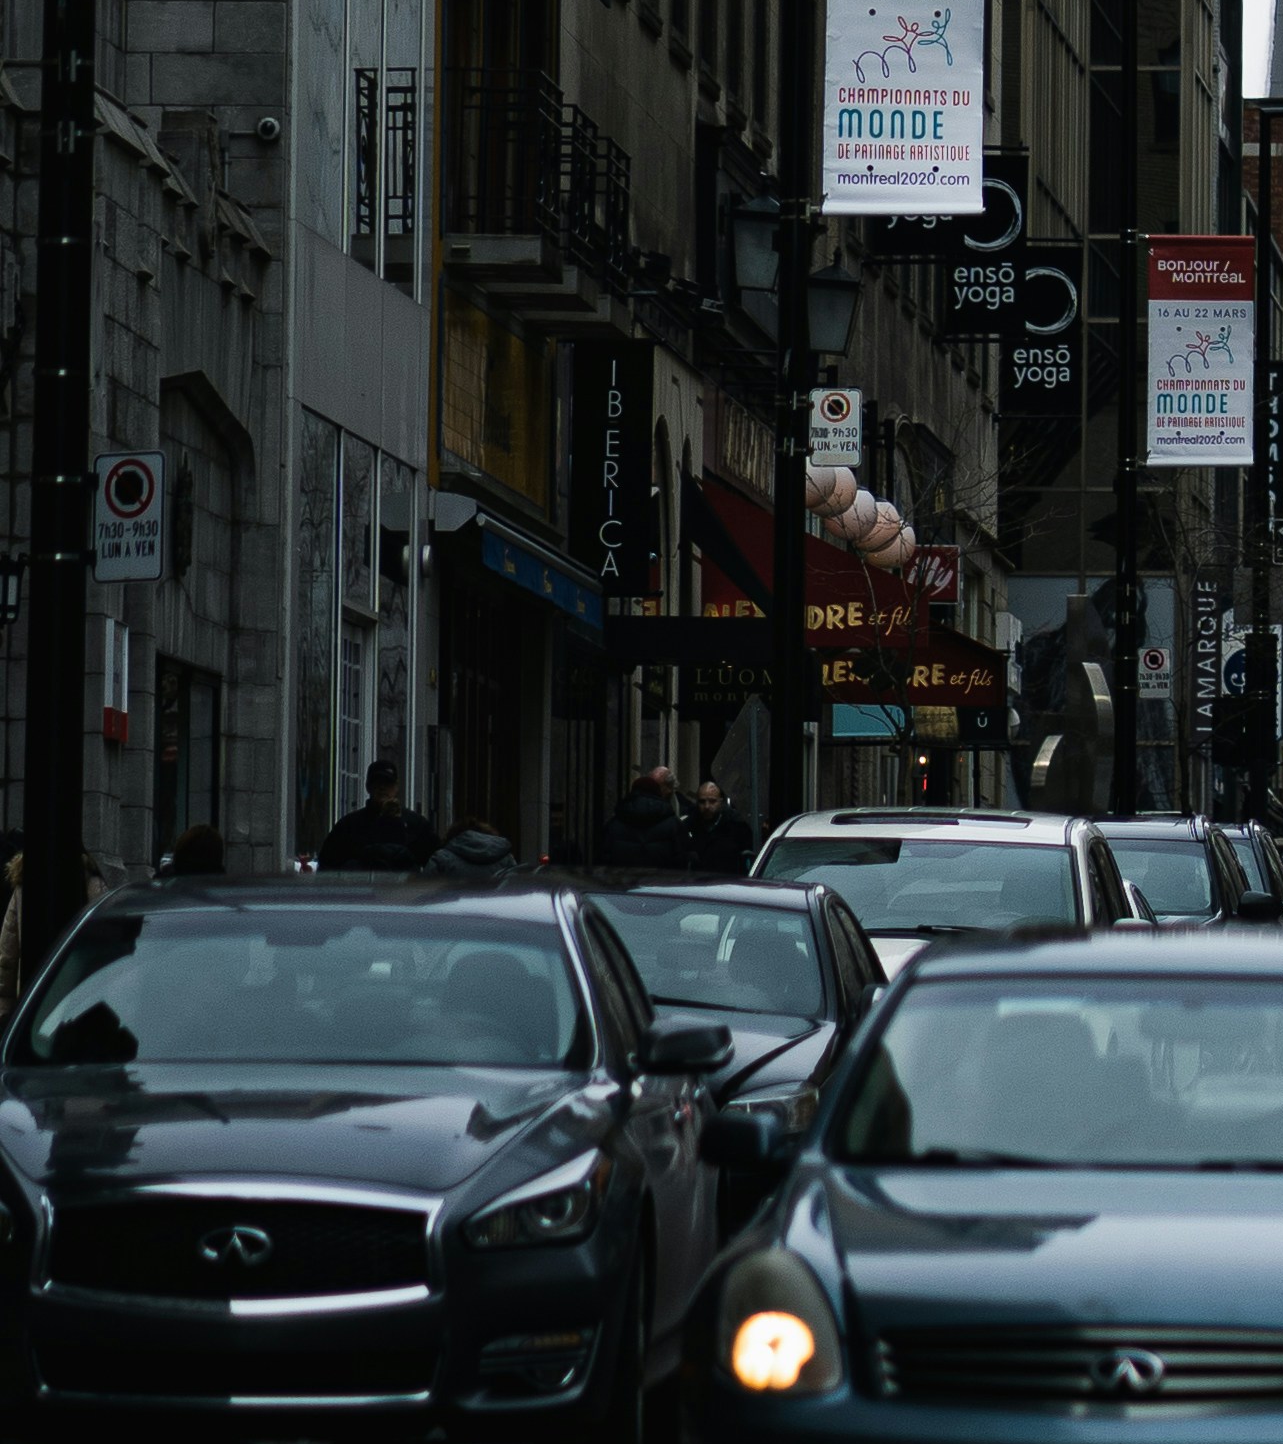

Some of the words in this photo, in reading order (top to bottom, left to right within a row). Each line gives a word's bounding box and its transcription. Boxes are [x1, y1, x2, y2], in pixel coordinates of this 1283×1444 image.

[838, 87, 947, 106] CHAMPIONNATS
[953, 90, 970, 106] DU
[838, 108, 944, 140] MONDE
[838, 143, 850, 159] DE
[854, 144, 905, 160] PATINAGE
[910, 145, 970, 161] ARTISTIQUE
[838, 171, 970, 185] montreal2020.com
[954, 286, 1015, 310] yoga
[1158, 308, 1169, 317] 16
[1174, 308, 1190, 317] AU
[1195, 308, 1208, 318] 22
[1213, 308, 1247, 318] MARS
[1013, 366, 1070, 389] yoga
[1233, 379, 1246, 391] DU
[1157, 394, 1228, 413] MONDE
[599, 359, 623, 577] IBERICA
[102, 541, 121, 559] LUN
[135, 540, 154, 557] VEN
[950, 673, 967, 686] et
[964, 669, 994, 694] fils
